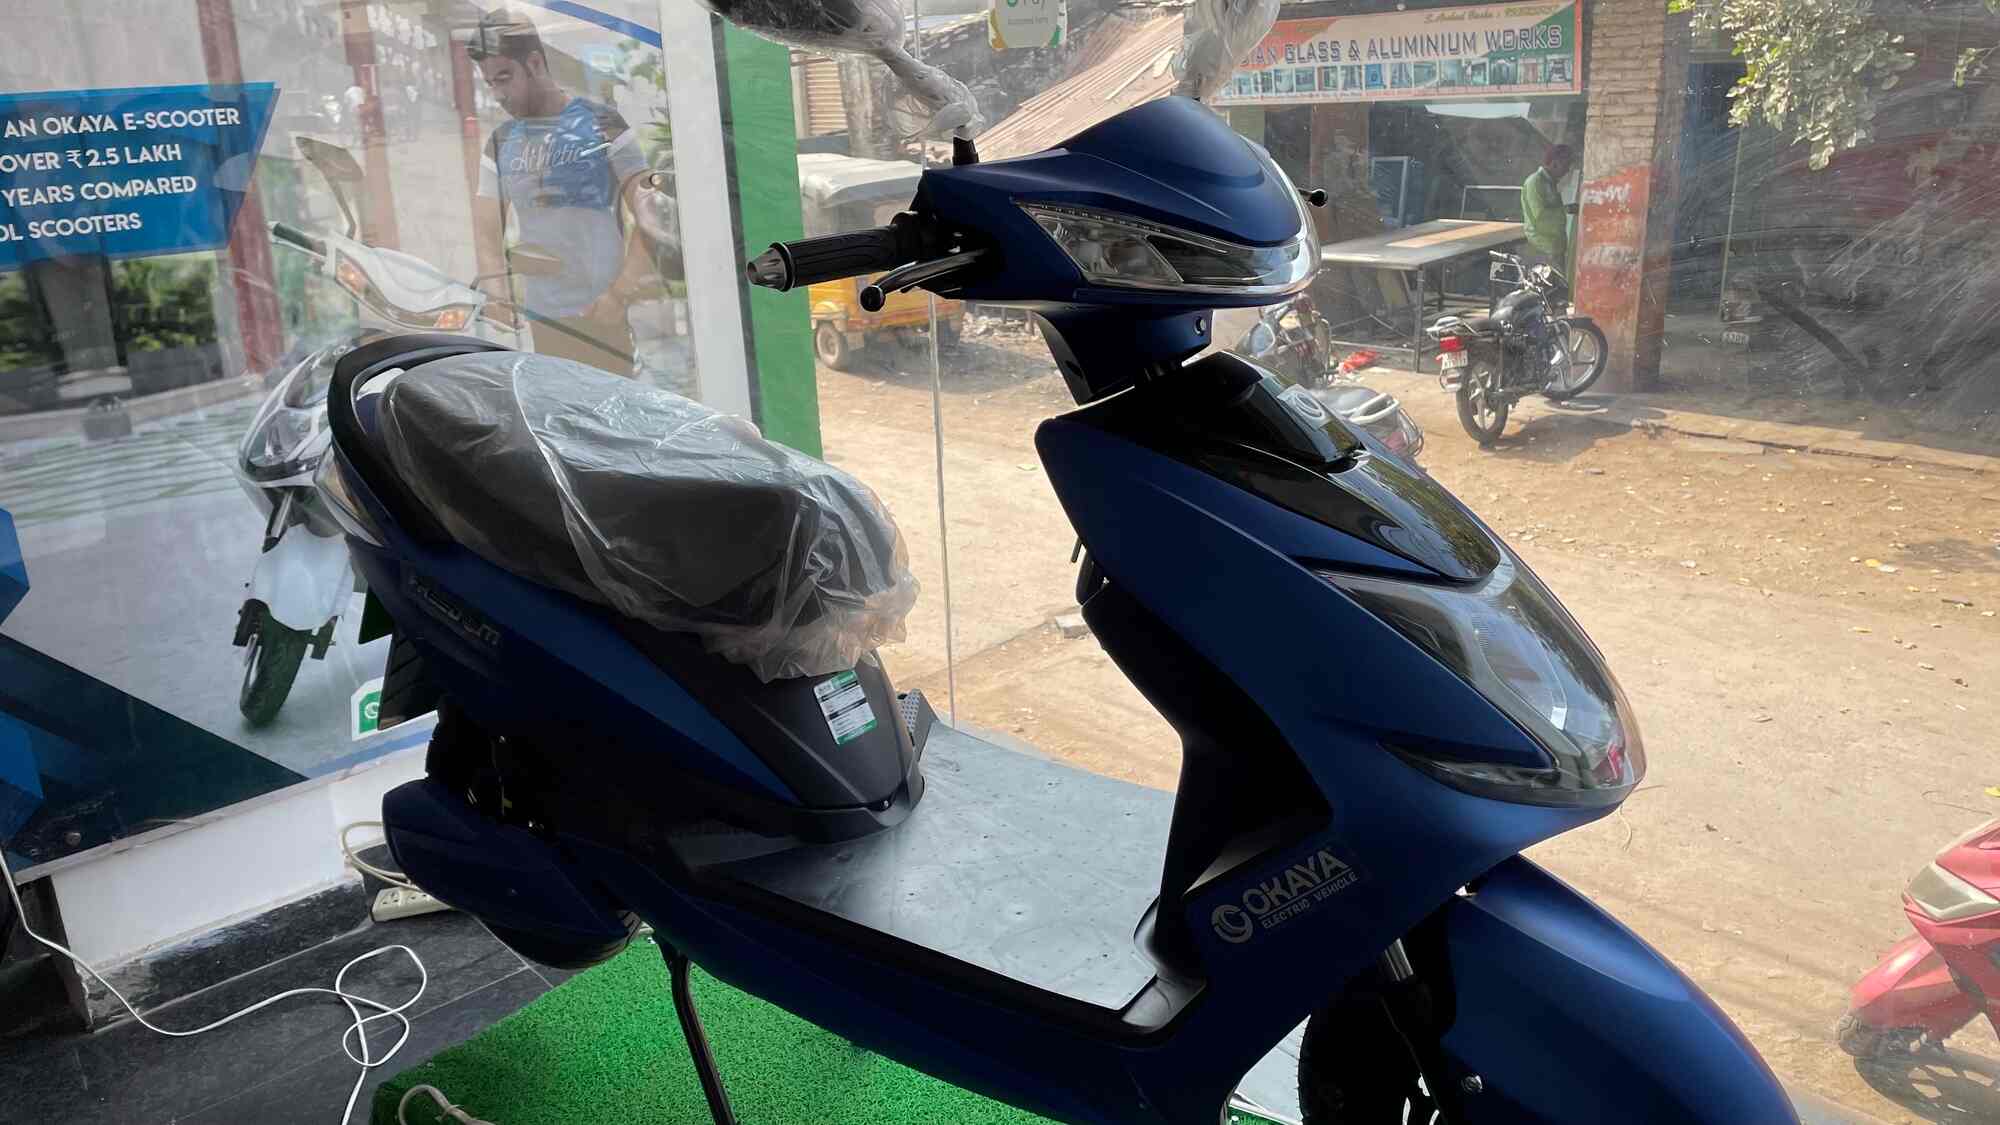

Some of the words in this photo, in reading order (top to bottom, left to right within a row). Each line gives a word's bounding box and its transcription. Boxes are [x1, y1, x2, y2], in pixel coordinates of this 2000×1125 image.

[1285, 40, 1342, 64] GLASS
[1348, 39, 1361, 62] &
[1367, 31, 1477, 61] ALUMINIUM
[1485, 25, 1562, 52] WORKS
[4, 118, 37, 138] AN
[43, 114, 118, 136] OKAYA
[123, 108, 240, 131] E-SCOOTER
[1, 151, 61, 173] OVER
[88, 147, 119, 167] 2.5
[124, 143, 182, 164] LAKH
[2, 180, 75, 208] YEARS
[80, 175, 197, 201] COMPARED
[28, 213, 142, 239] SCOOTERS
[1242, 850, 1349, 914] OKAYA
[1261, 898, 1311, 929] ELECTRIC
[1312, 871, 1359, 902] VEHICLE
